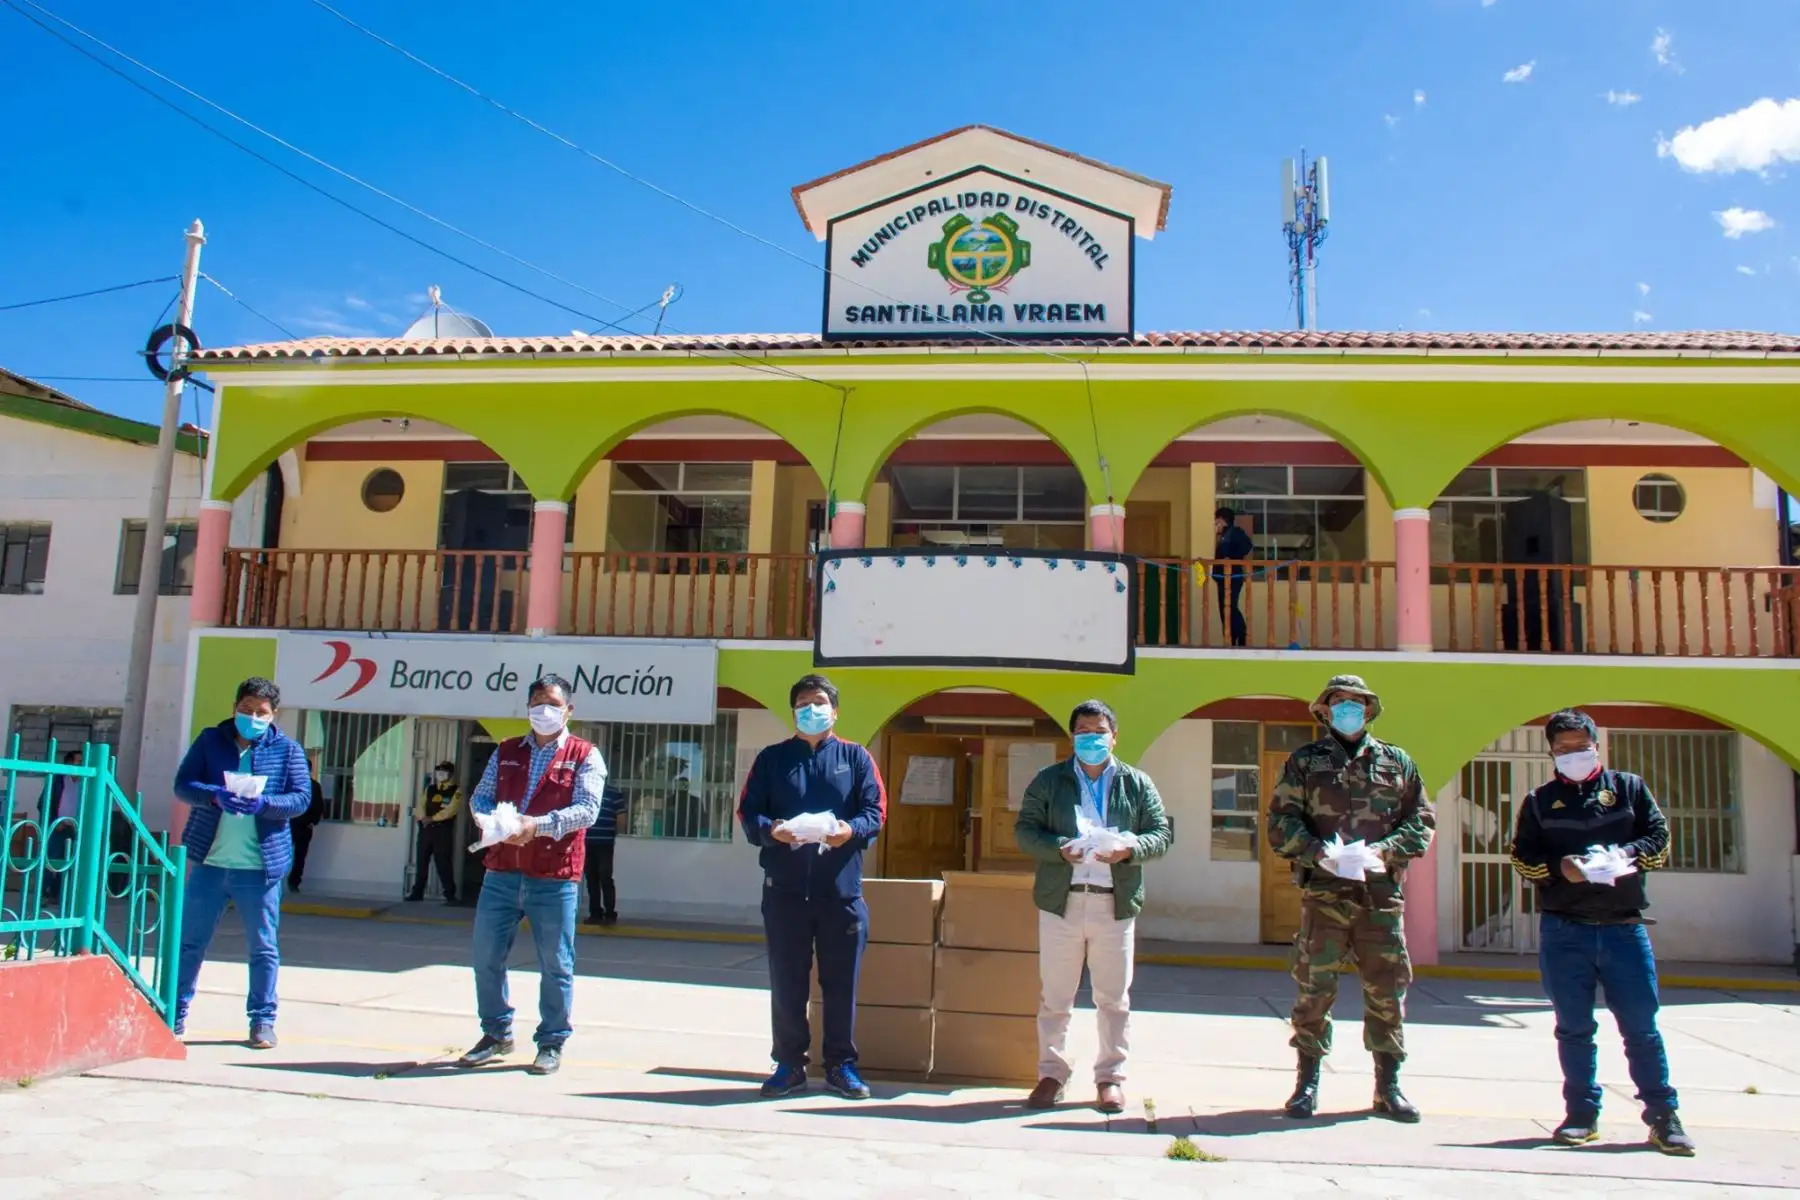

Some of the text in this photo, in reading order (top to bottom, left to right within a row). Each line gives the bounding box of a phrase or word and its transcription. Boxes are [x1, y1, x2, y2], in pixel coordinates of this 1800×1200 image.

[851, 191, 1110, 270] MUNICIPALIDAD DISTRITAL
[845, 303, 1106, 323] SANTILLANA VRAEM
[390, 660, 473, 691] Banco
[485, 662, 519, 692] de
[571, 664, 674, 696] Nación
